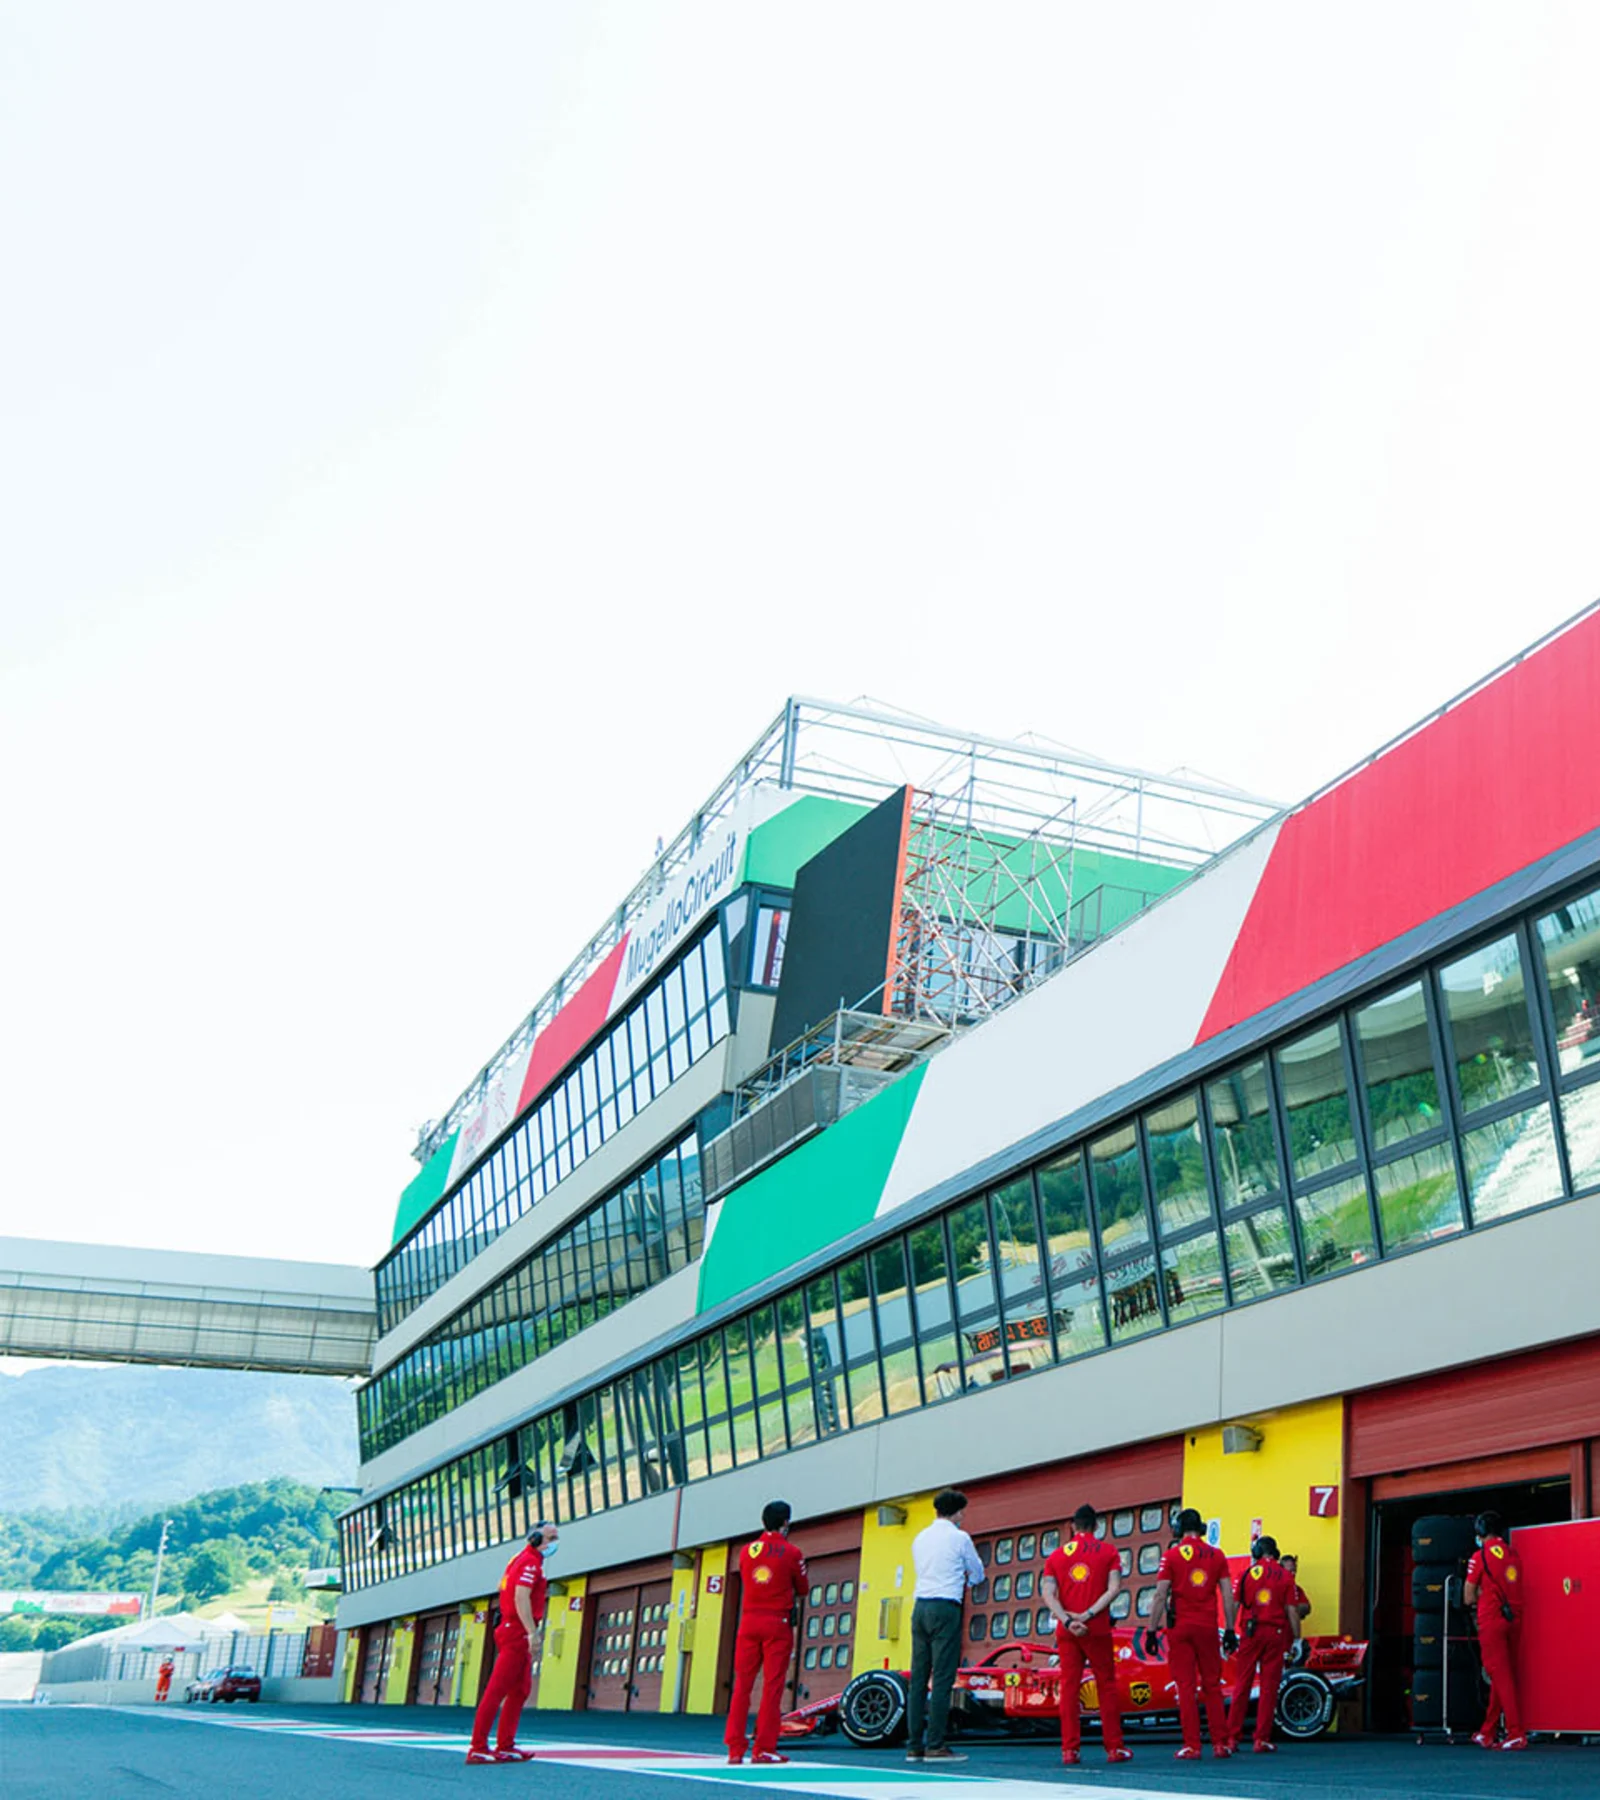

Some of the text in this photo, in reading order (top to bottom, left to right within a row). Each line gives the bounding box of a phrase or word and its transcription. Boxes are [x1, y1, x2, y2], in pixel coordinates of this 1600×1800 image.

[1315, 1487, 1334, 1515] 7
[709, 1576, 720, 1593] 5
[571, 1597, 581, 1610] 4
[476, 1611, 484, 1623] 3
